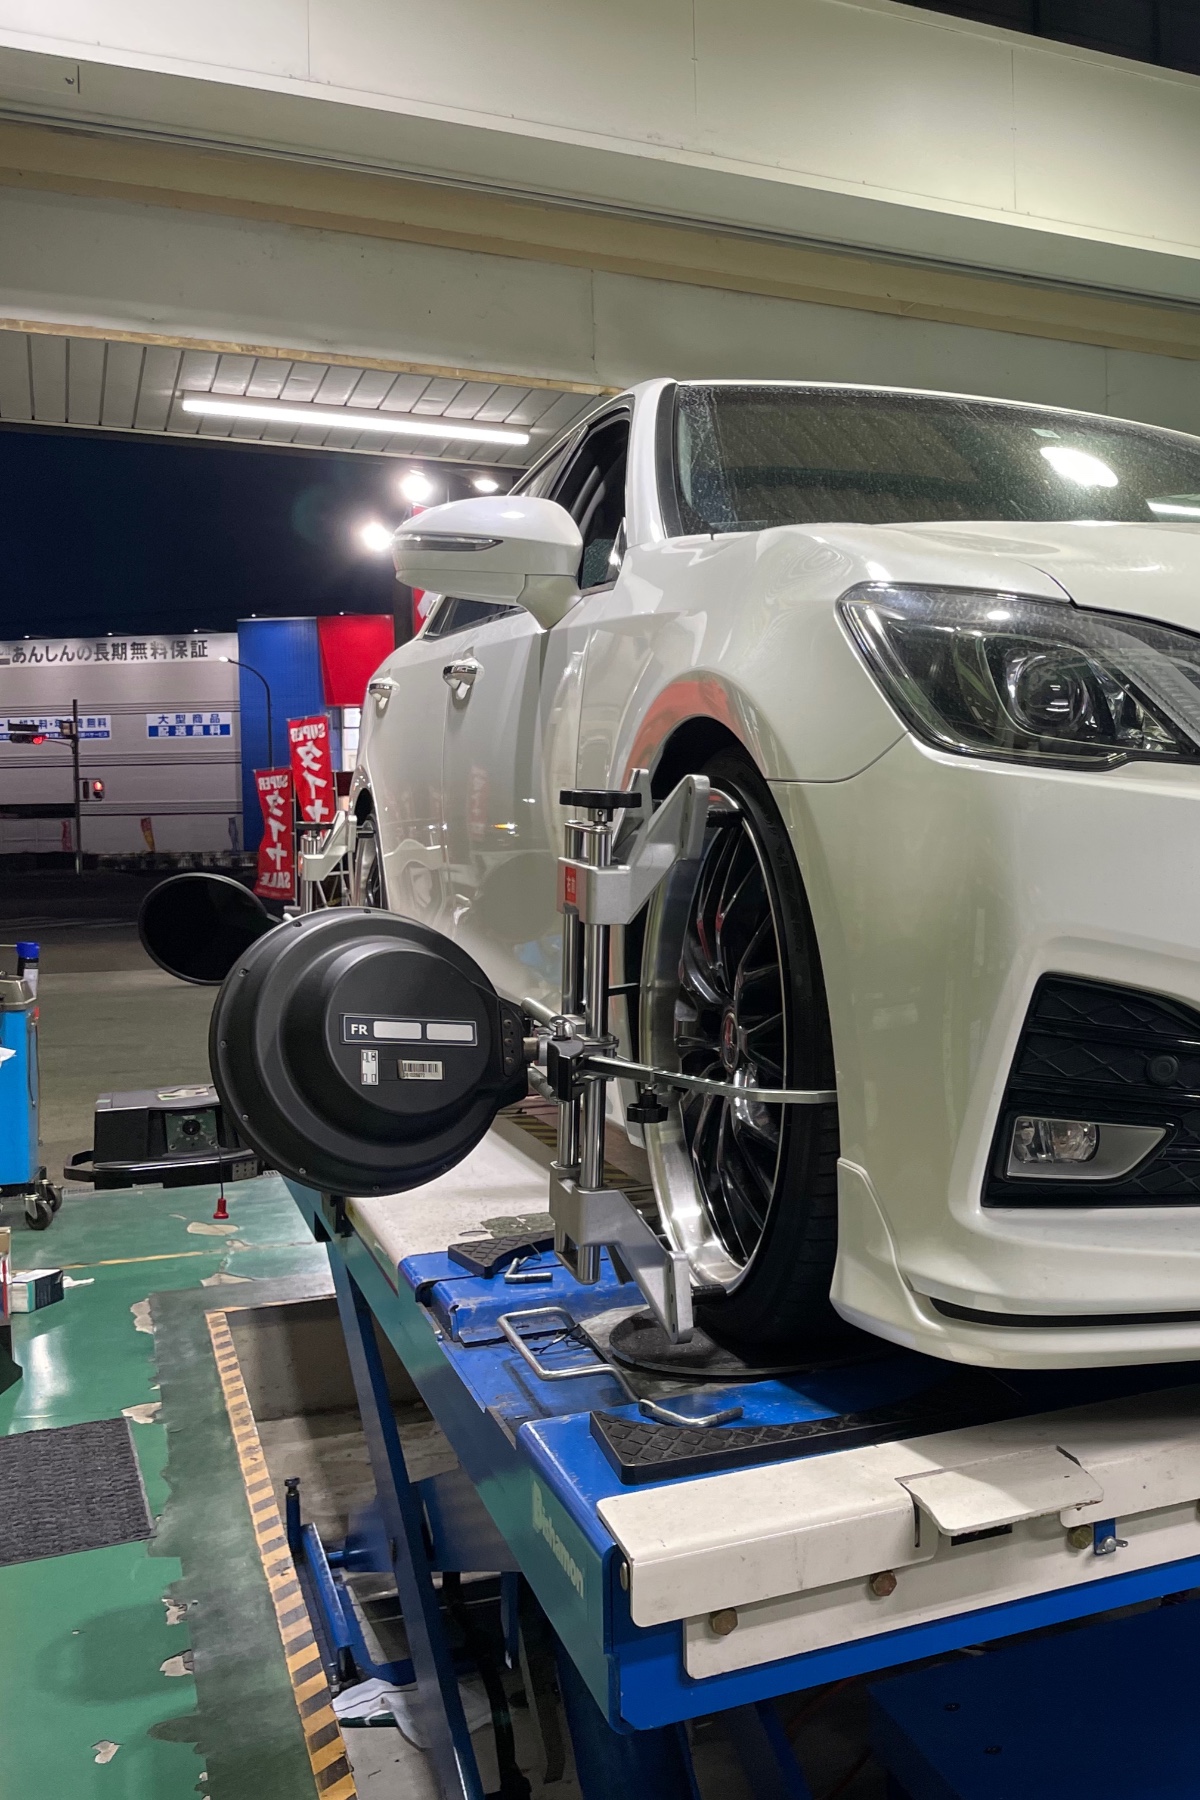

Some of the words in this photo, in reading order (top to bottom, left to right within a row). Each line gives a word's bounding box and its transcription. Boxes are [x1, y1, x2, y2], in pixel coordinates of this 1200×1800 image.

[12, 640, 209, 663] あんしんの長期無料保証
[157, 714, 221, 725] 大型商品
[351, 1023, 368, 1035] FR
